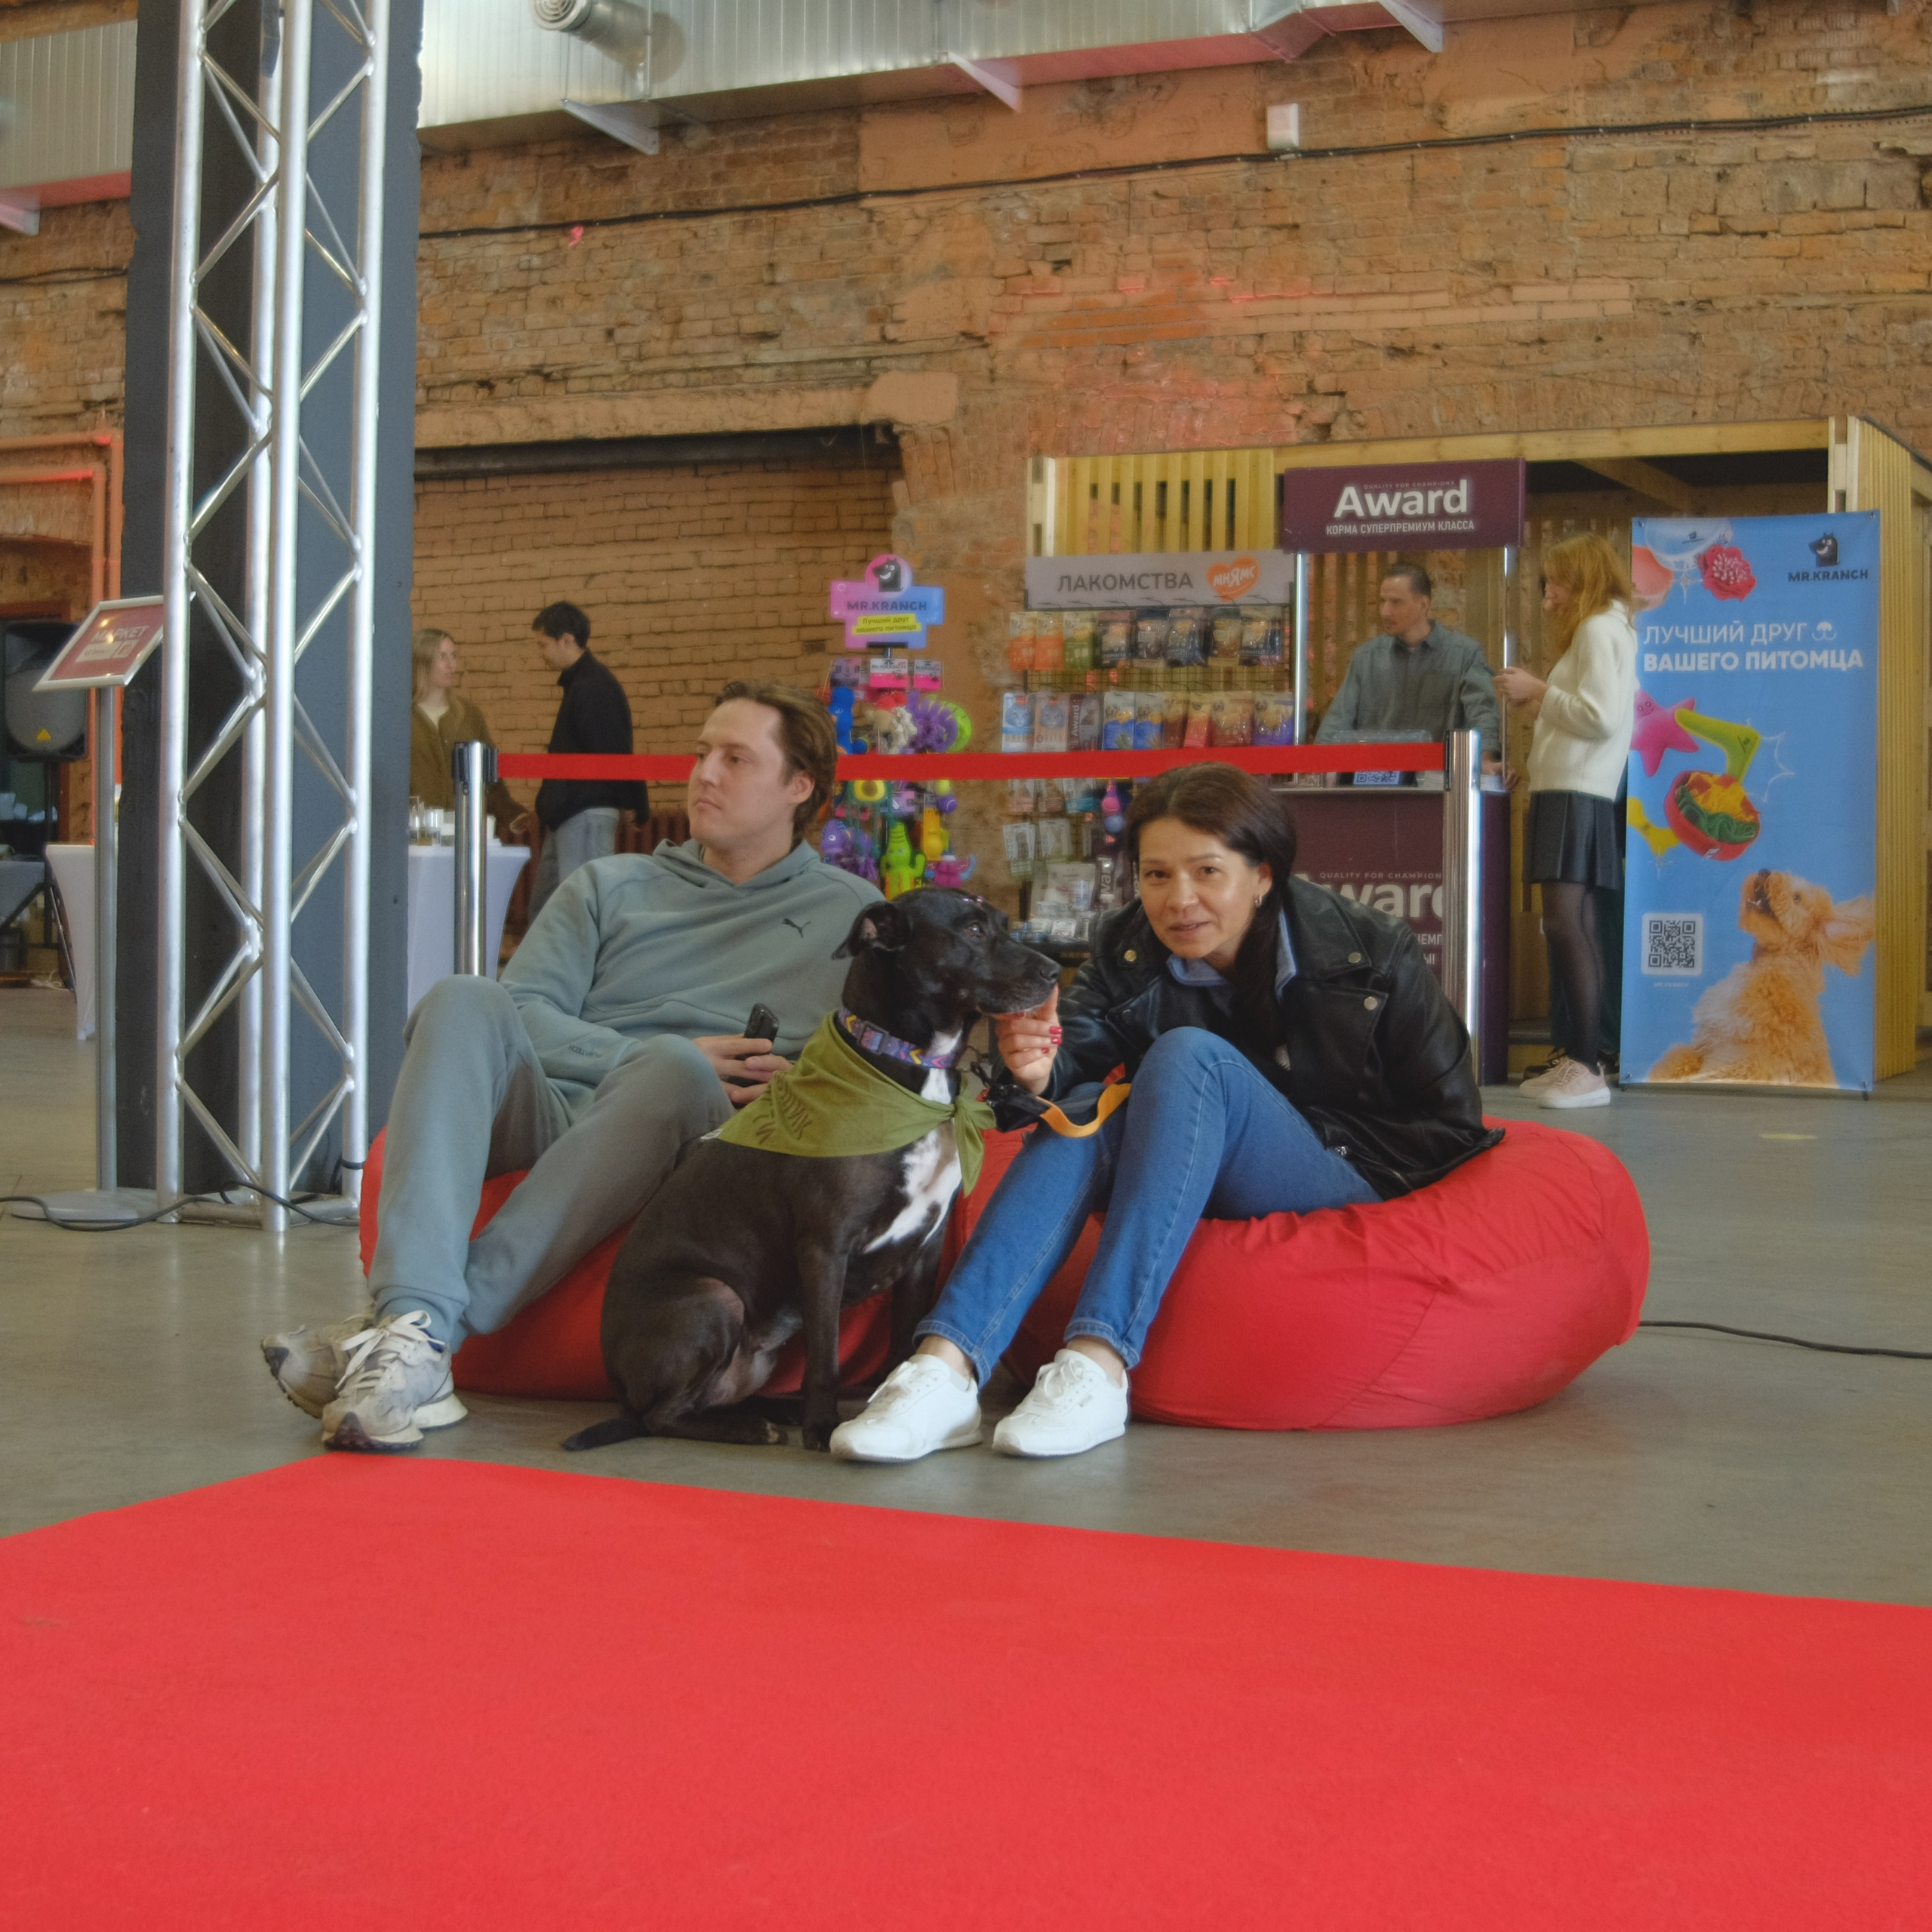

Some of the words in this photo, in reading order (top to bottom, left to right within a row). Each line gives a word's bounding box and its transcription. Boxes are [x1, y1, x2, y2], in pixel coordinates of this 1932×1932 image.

[1334, 479, 1468, 518] Award
[1326, 524, 1358, 535] КОРМА
[1360, 522, 1435, 534] СУПЕРПРЕМИУМ
[1438, 520, 1475, 531] КЛАССА
[1057, 572, 1194, 592] ЛАКОМСТВА
[1787, 569, 1869, 583] MR.KRANCH
[846, 601, 927, 611] MR.KRANCH
[1643, 620, 1744, 645] ЛУЧШИЙ
[1750, 623, 1807, 645] ДРУГ
[1644, 651, 1739, 672] ВАШЕГО
[1745, 649, 1864, 672] ПИТОМЦА
[1071, 704, 1080, 737] Award
[1387, 871, 1442, 879] CHAMPION
[1294, 873, 1443, 921] war
